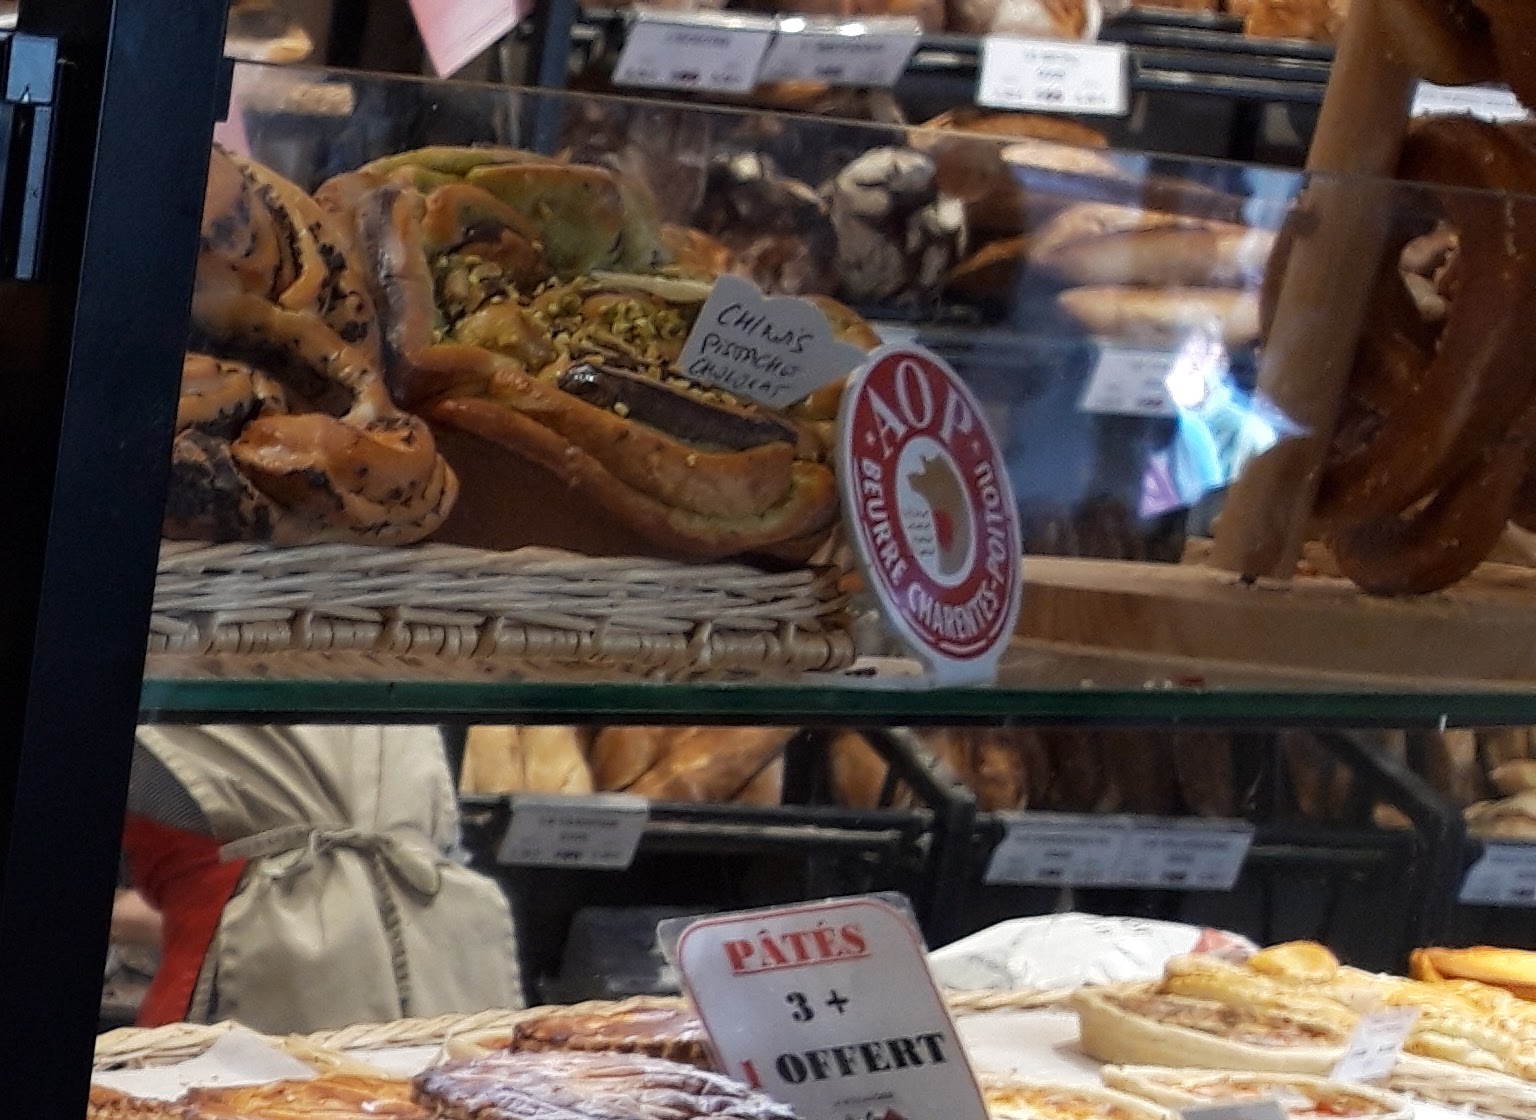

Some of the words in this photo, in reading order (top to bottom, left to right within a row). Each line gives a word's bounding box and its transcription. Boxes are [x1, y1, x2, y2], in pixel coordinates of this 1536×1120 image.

[865, 360, 974, 458] AOP
[861, 458, 909, 586] BEURRE
[723, 920, 868, 972] PÂTÉS
[786, 990, 814, 1022] 3
[826, 989, 849, 1014] +
[776, 1031, 947, 1084] OFFERT
